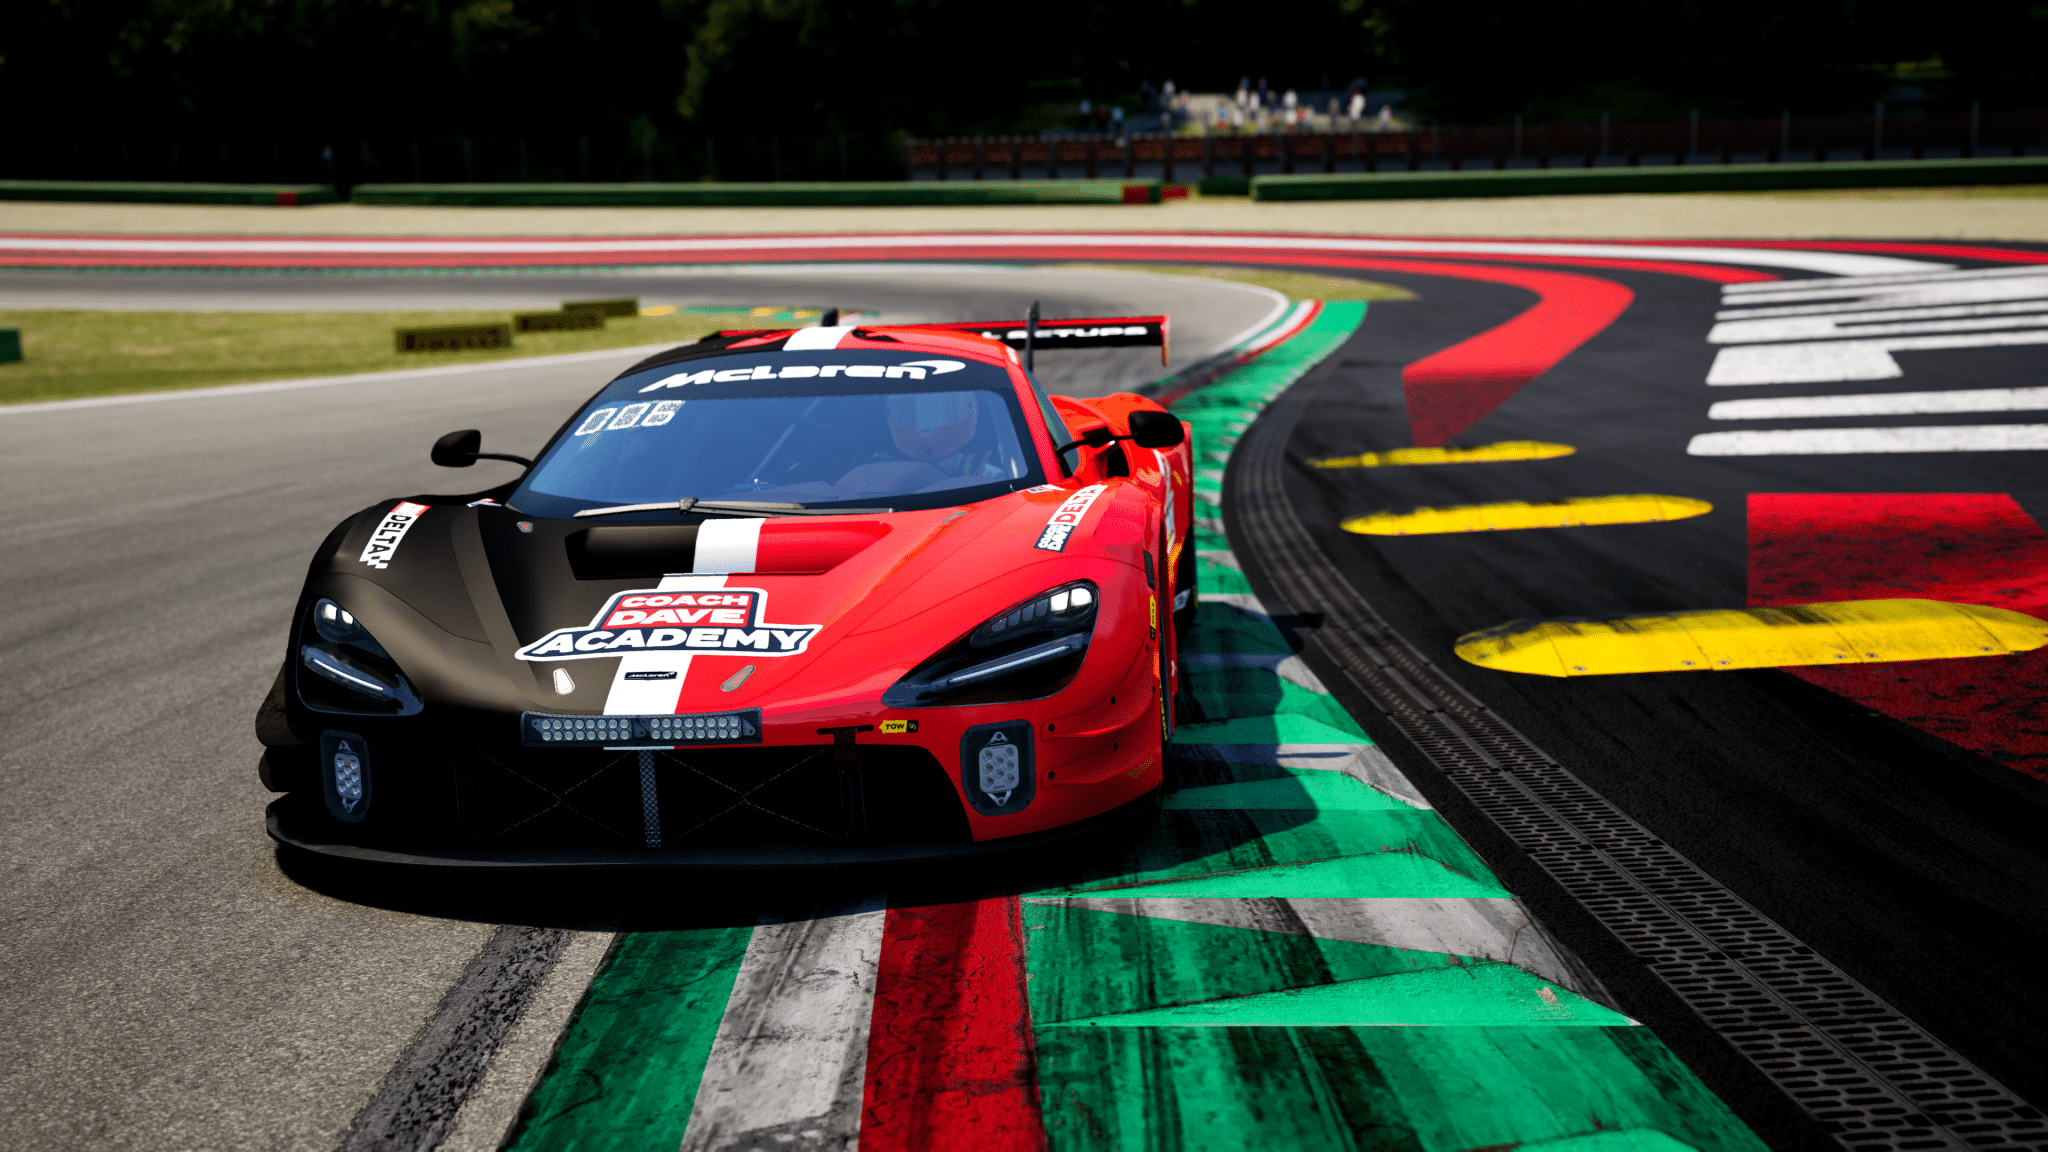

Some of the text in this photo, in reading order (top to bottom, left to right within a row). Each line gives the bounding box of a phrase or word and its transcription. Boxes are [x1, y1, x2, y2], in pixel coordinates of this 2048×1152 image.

[638, 360, 966, 393] McLaren
[367, 514, 412, 555] DELTA
[621, 594, 749, 608] COACH
[606, 608, 746, 626] DAVE
[532, 628, 809, 654] ACADEMY
